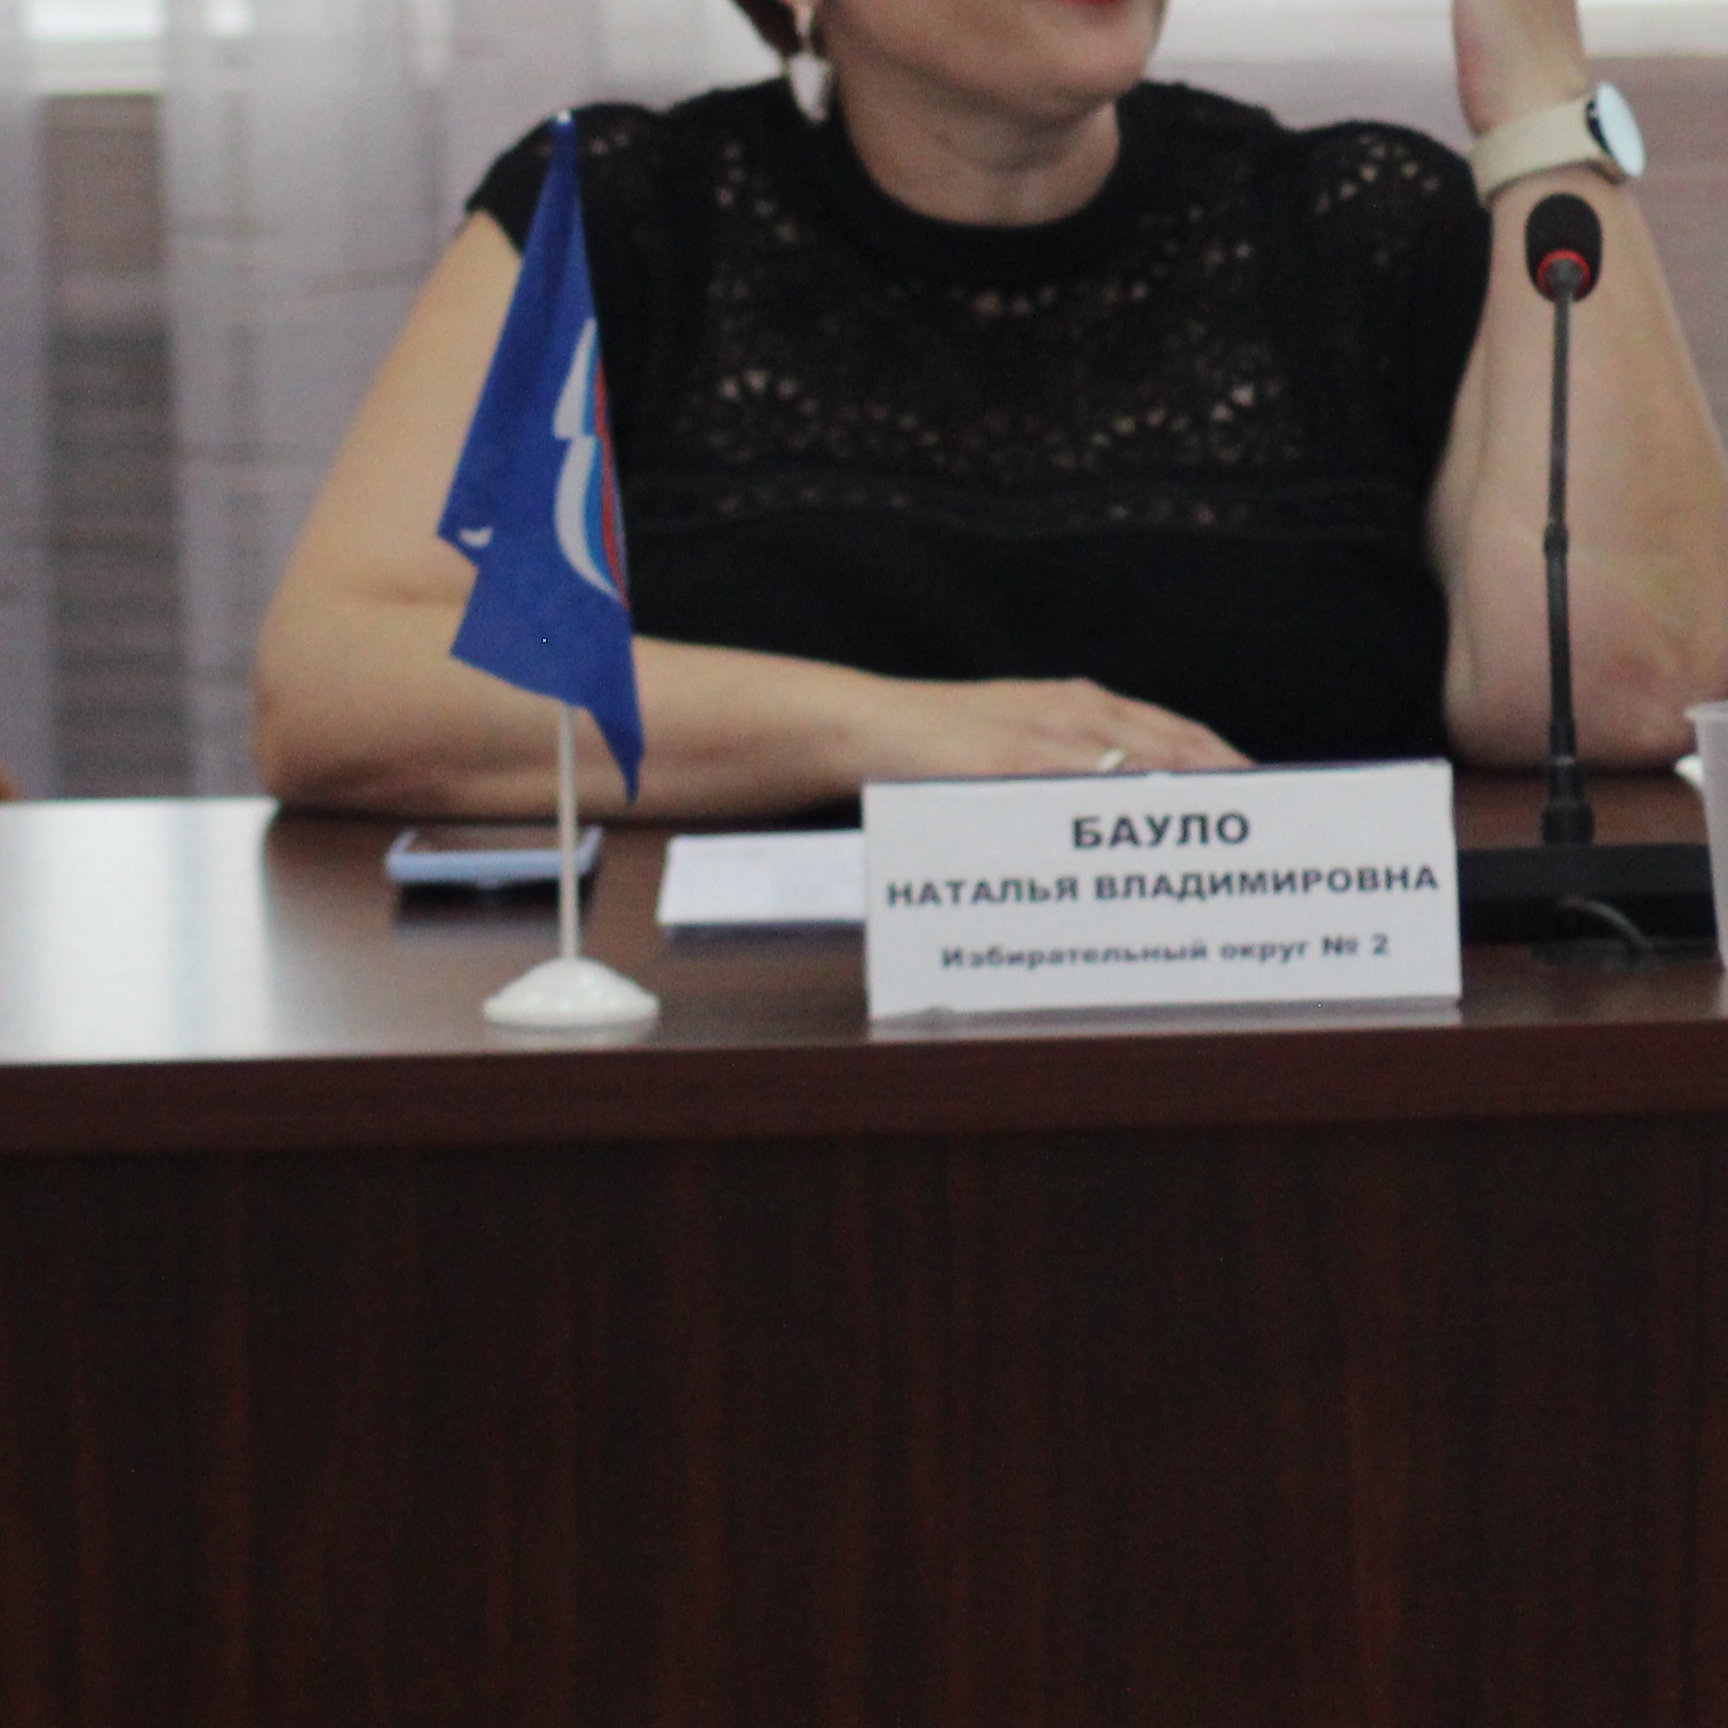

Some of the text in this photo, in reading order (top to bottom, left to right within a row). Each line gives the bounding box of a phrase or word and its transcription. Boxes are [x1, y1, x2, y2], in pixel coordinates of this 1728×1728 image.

[1071, 811, 1250, 850] БАУЛО
[886, 865, 1439, 908] НАТАЛЬЯ ВЛАДИМИРОВНА
[940, 932, 1389, 972] Избирательный округ № 2
